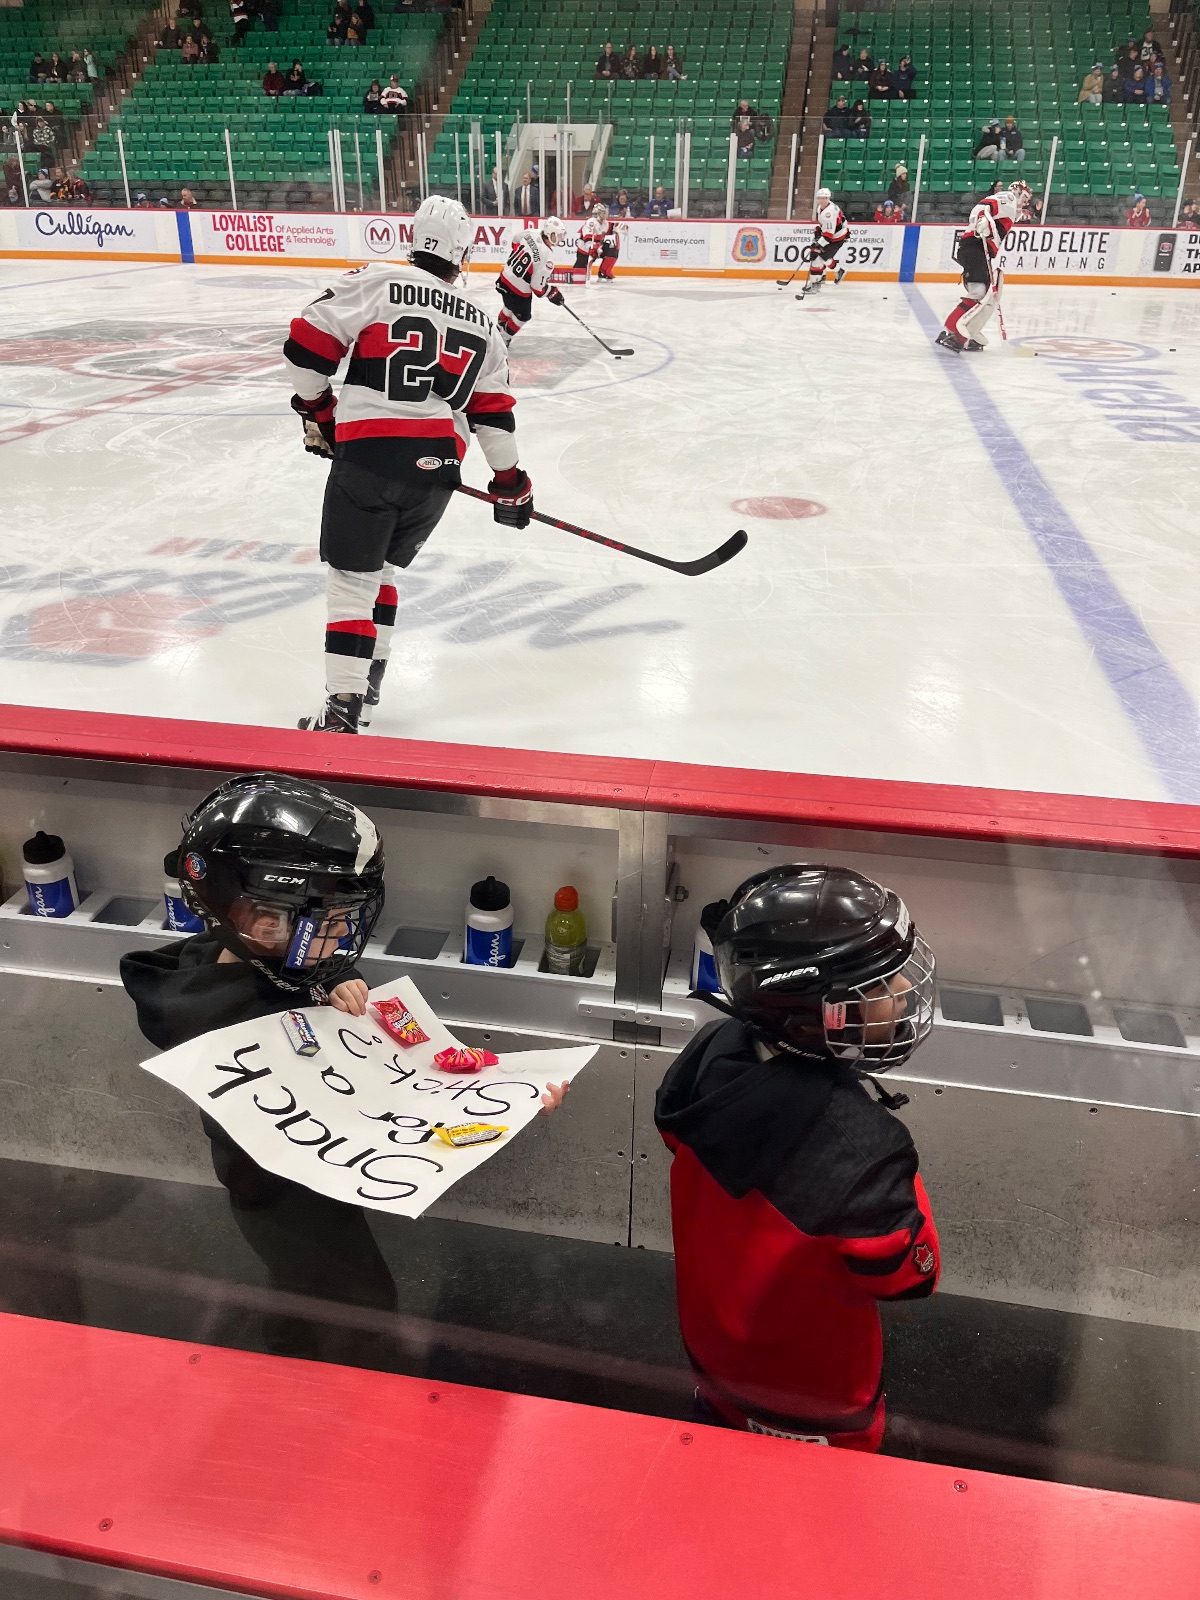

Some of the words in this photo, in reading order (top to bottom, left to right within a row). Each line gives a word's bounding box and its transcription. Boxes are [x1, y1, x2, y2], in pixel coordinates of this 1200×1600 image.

[35, 211, 134, 247] Culligan
[286, 226, 315, 235] Applied
[316, 227, 334, 235] Arts
[225, 234, 285, 252] COLLEGE
[293, 236, 336, 246] Technology
[424, 237, 439, 251] 27
[634, 235, 705, 246] TeamGuernsey.com
[1003, 230, 1053, 253] ORLD
[1057, 231, 1110, 254] ELITE
[845, 246, 884, 265] 397
[999, 256, 1105, 270] RAINING
[387, 315, 488, 413] 27
[263, 874, 306, 886] CCM
[320, 1065, 355, 1096] a
[207, 1042, 443, 1201] Snack
